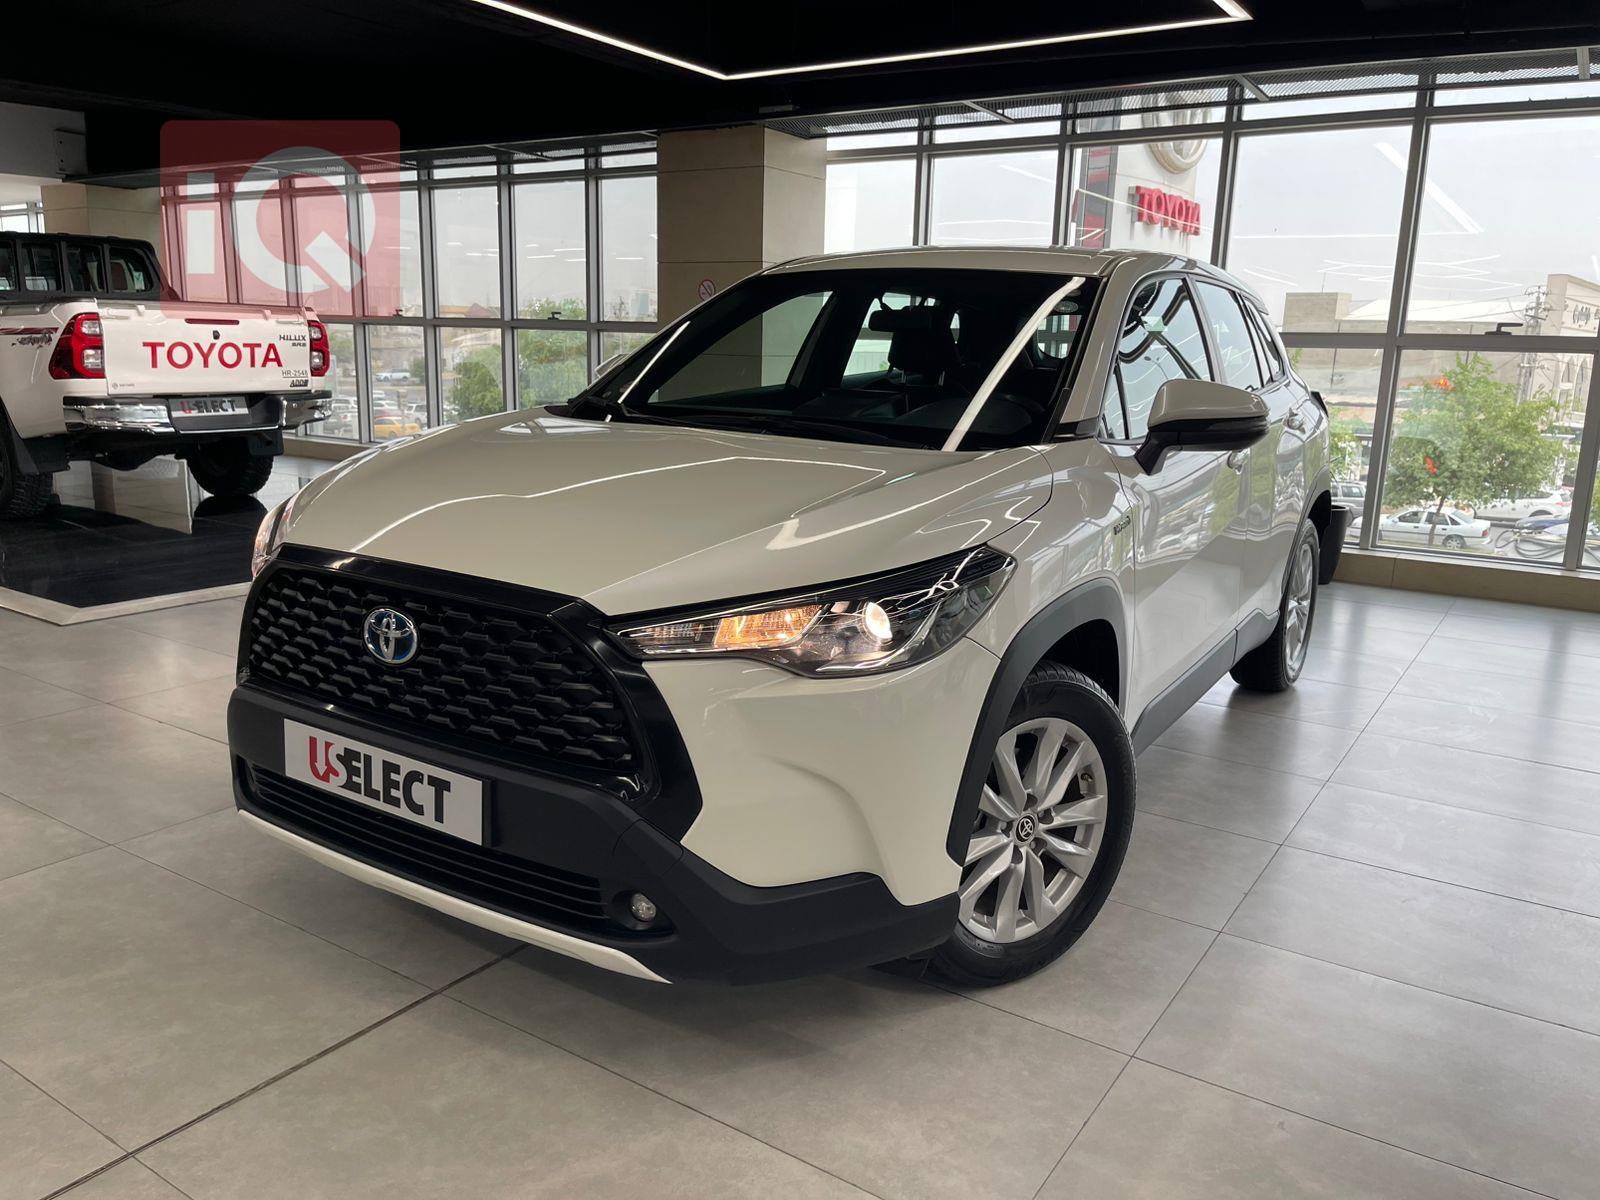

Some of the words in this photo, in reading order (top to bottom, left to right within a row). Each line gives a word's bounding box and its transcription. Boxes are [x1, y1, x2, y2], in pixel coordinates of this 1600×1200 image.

[1135, 185, 1201, 237] TOYOTA
[142, 341, 283, 369] TOYOTA
[309, 736, 451, 824] USELECT
